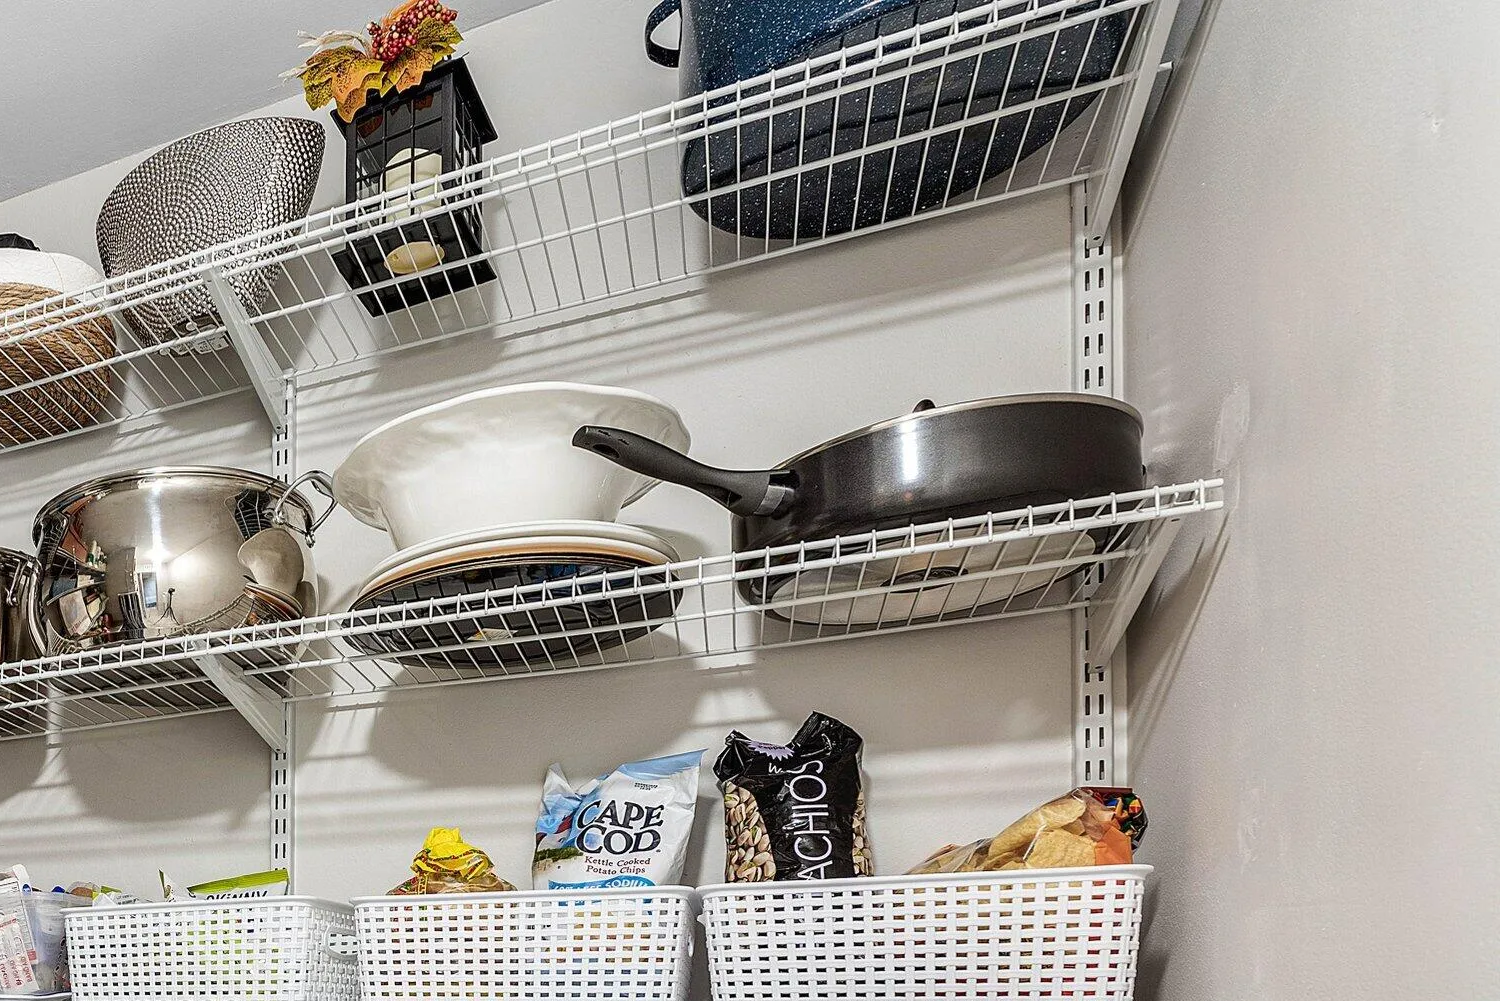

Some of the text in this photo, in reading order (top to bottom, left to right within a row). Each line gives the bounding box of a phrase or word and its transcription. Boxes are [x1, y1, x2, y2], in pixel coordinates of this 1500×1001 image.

[577, 800, 664, 829] CAPE
[576, 825, 661, 855] COD
[585, 856, 651, 867] Kettle Cooked
[586, 866, 646, 876] Potato Chips
